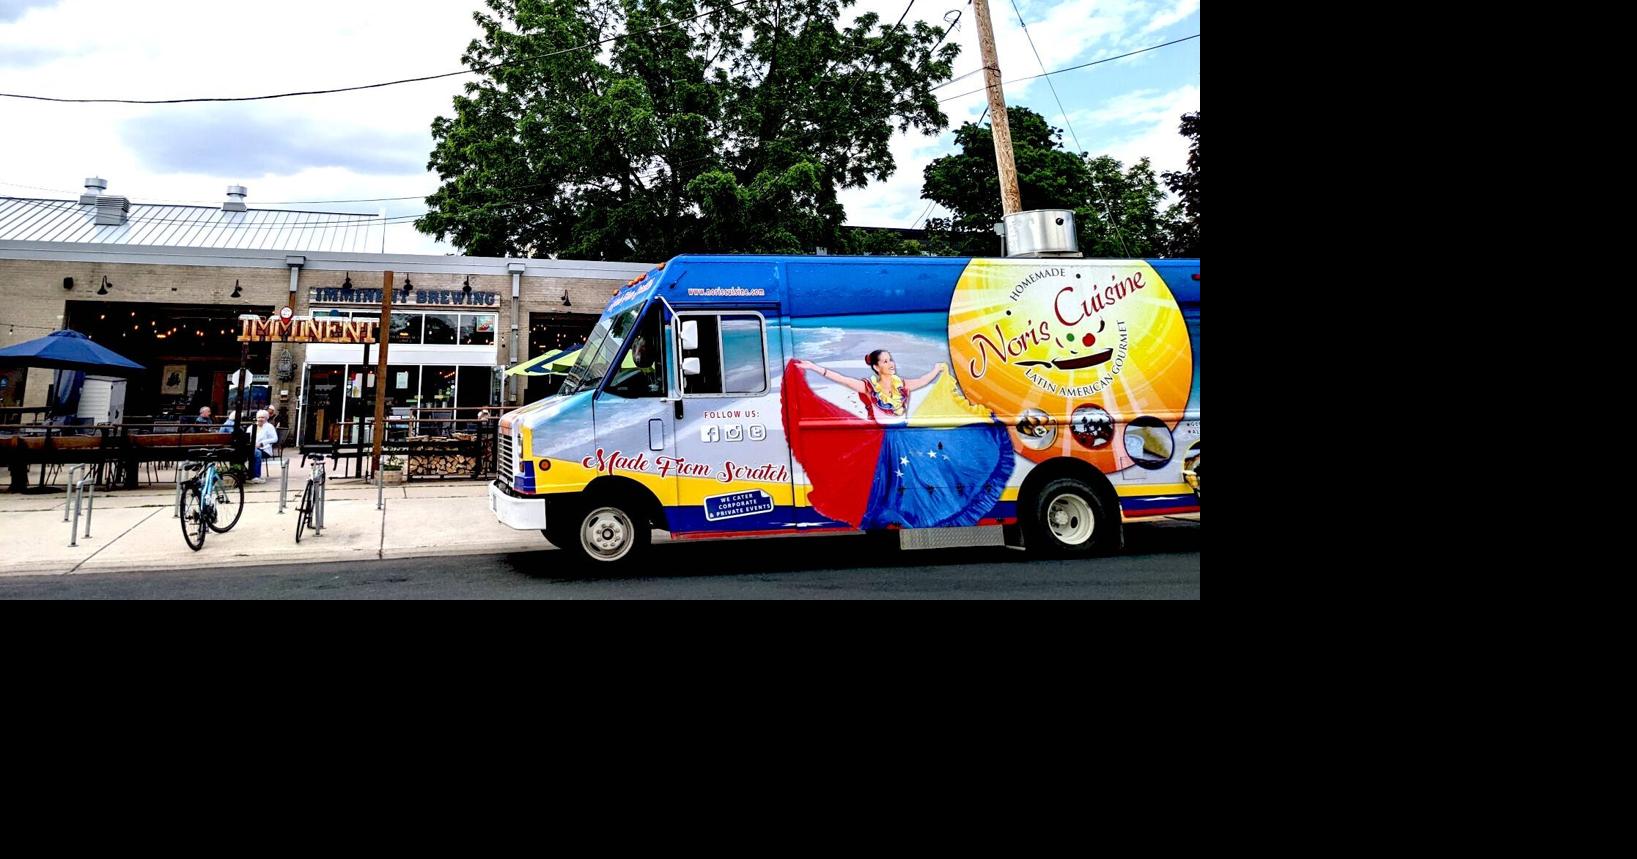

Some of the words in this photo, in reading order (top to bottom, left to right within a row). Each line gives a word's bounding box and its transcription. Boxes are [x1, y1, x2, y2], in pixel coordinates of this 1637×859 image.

[1010, 268, 1066, 302] HOMEMADE
[416, 290, 496, 305] BREWING
[237, 313, 380, 343] IMMINENT
[970, 319, 1051, 379] Noris
[1054, 271, 1146, 327] Cuisine
[1025, 368, 1057, 393] LATIN
[1059, 374, 1113, 397] AMERICAN
[1112, 319, 1128, 375] GOURMET
[704, 410, 741, 419] FOLLOW
[745, 410, 760, 418] US:
[583, 448, 649, 475] Made
[655, 455, 710, 478] From
[717, 461, 789, 483] Scratch
[718, 499, 757, 510] CORPORATE
[732, 493, 753, 501] CATER
[716, 507, 744, 517] PRIVATE
[745, 503, 771, 513] EVENTS
